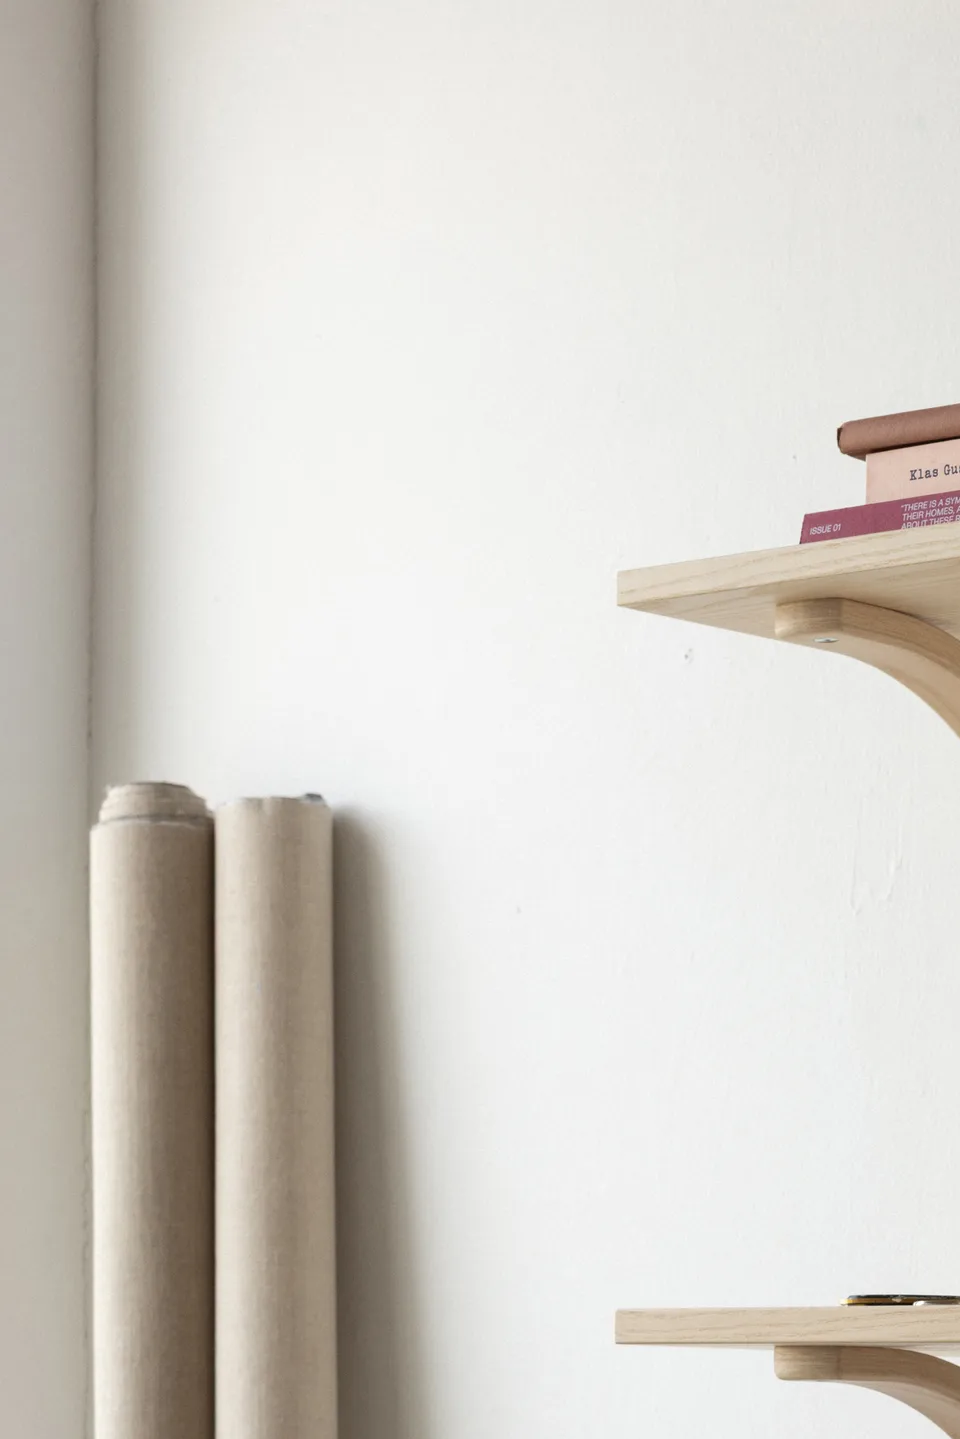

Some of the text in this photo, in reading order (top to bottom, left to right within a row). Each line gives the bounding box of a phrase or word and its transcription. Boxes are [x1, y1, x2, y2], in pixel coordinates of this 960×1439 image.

[909, 468, 939, 481] Klas
[929, 499, 937, 508] IS
[938, 498, 944, 507] A
[902, 510, 925, 522] THEIR
[809, 523, 842, 535] ISSUE 01
